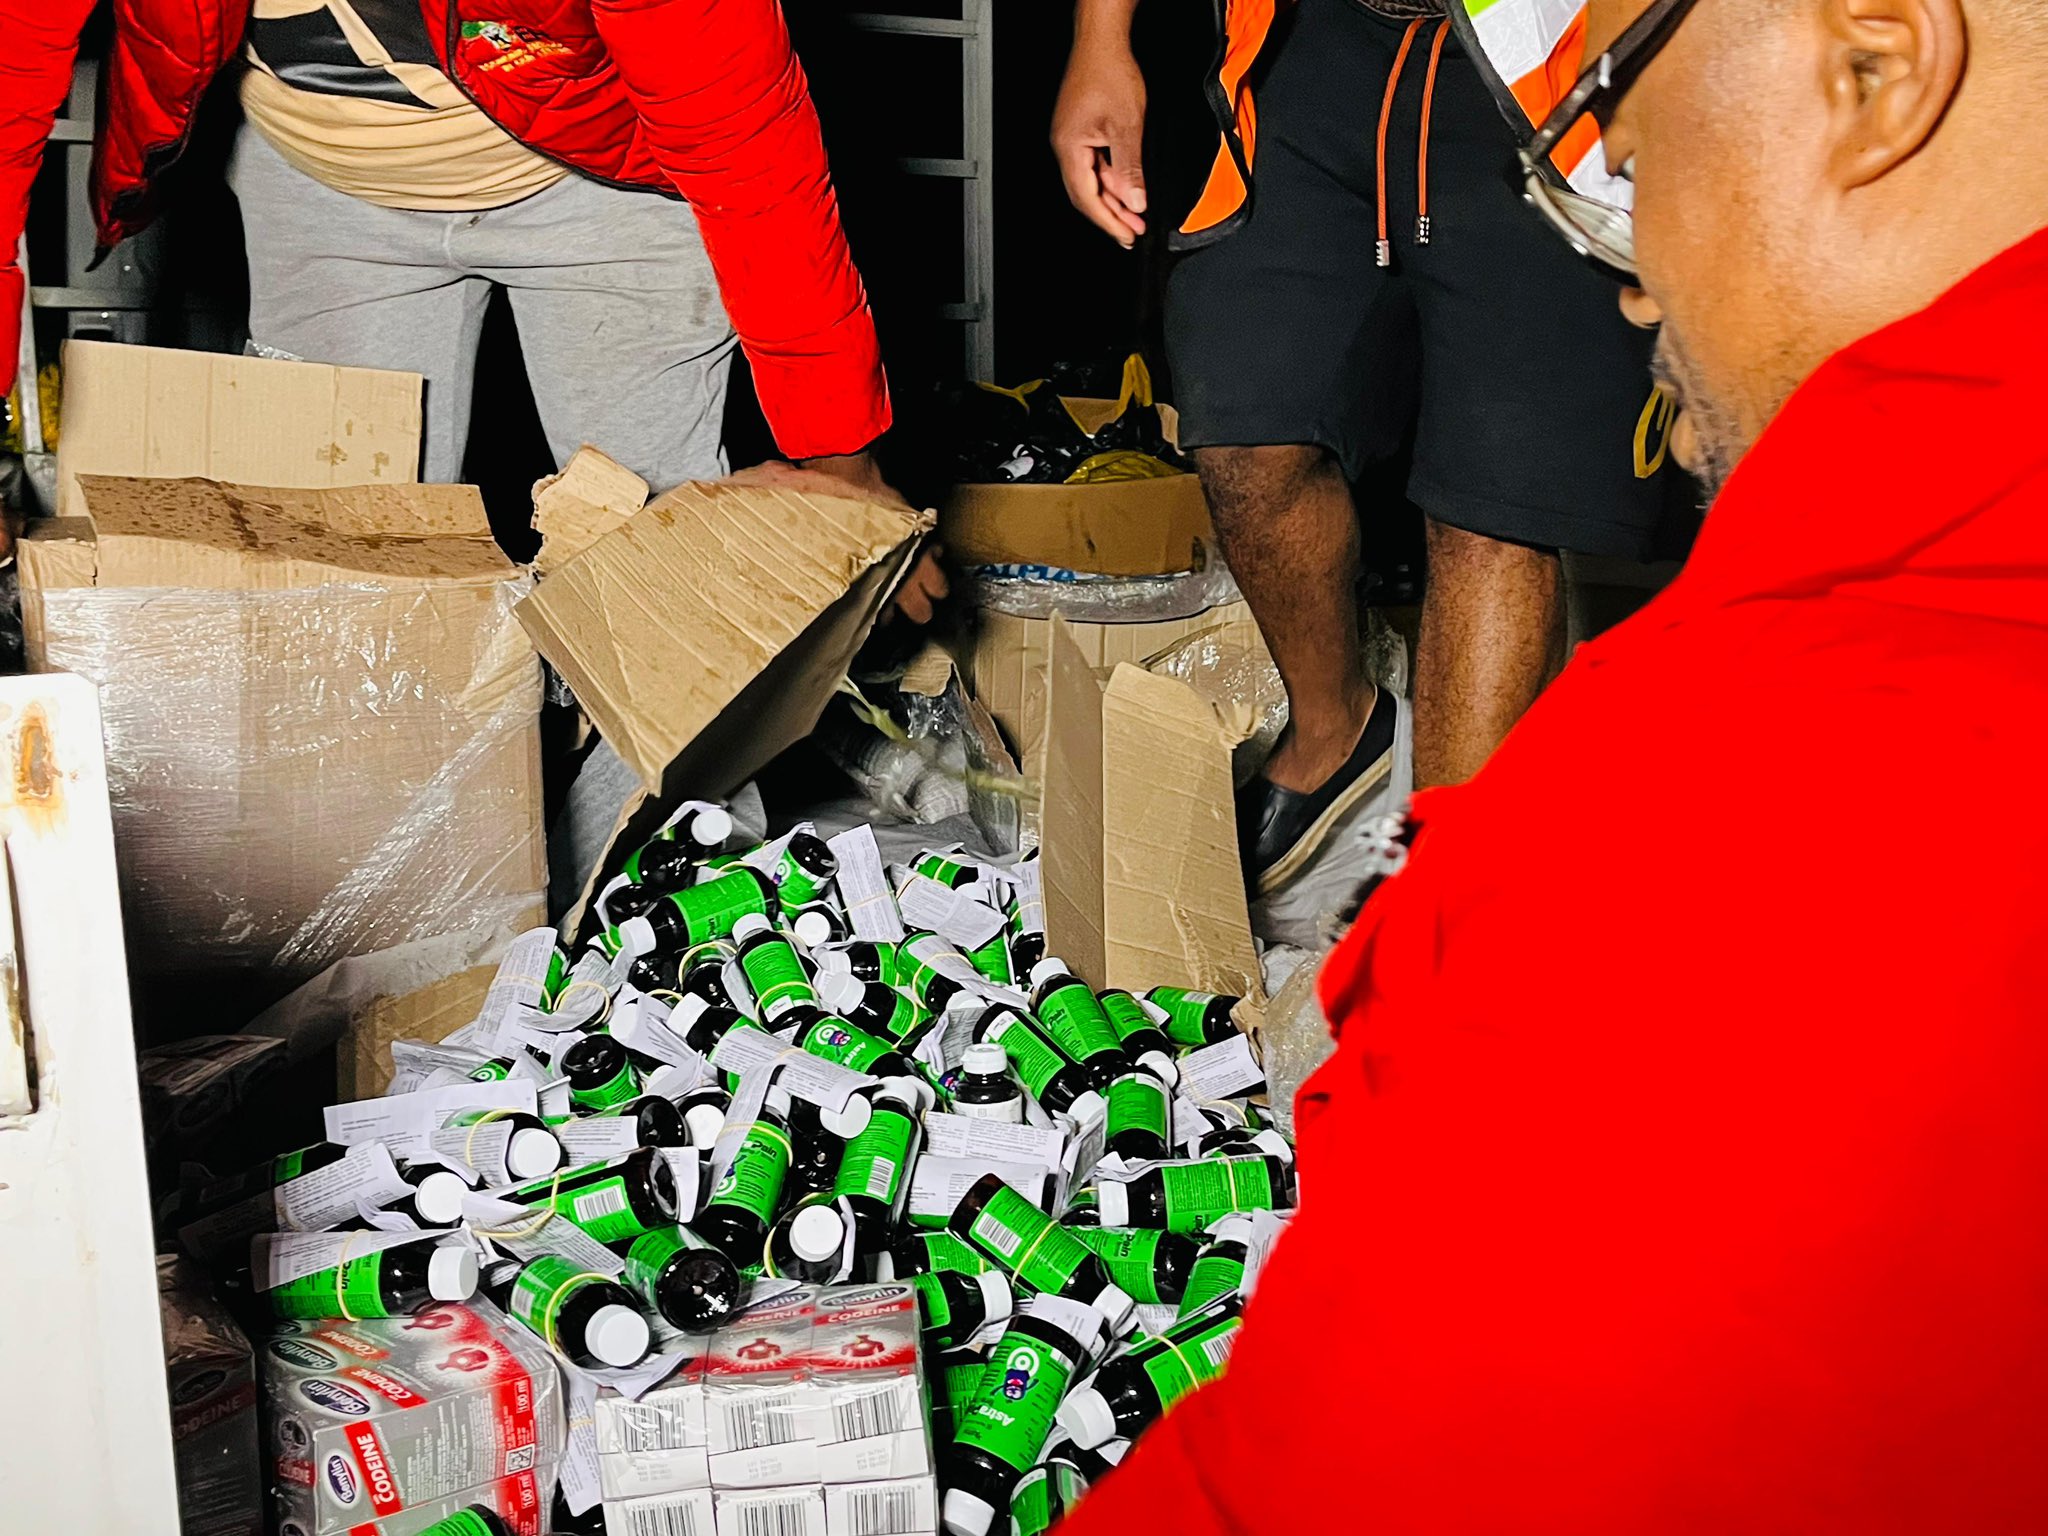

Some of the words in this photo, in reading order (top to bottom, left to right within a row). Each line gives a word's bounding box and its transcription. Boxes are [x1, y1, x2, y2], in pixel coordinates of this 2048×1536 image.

[827, 1305, 900, 1323] CODEINE
[278, 1340, 332, 1370] Benylin
[307, 1380, 367, 1414] Benylin
[351, 1368, 413, 1401] CODEINE
[174, 1395, 242, 1441] ODEINE
[331, 1458, 354, 1501] Benylin
[356, 1433, 395, 1505] CODEINE
